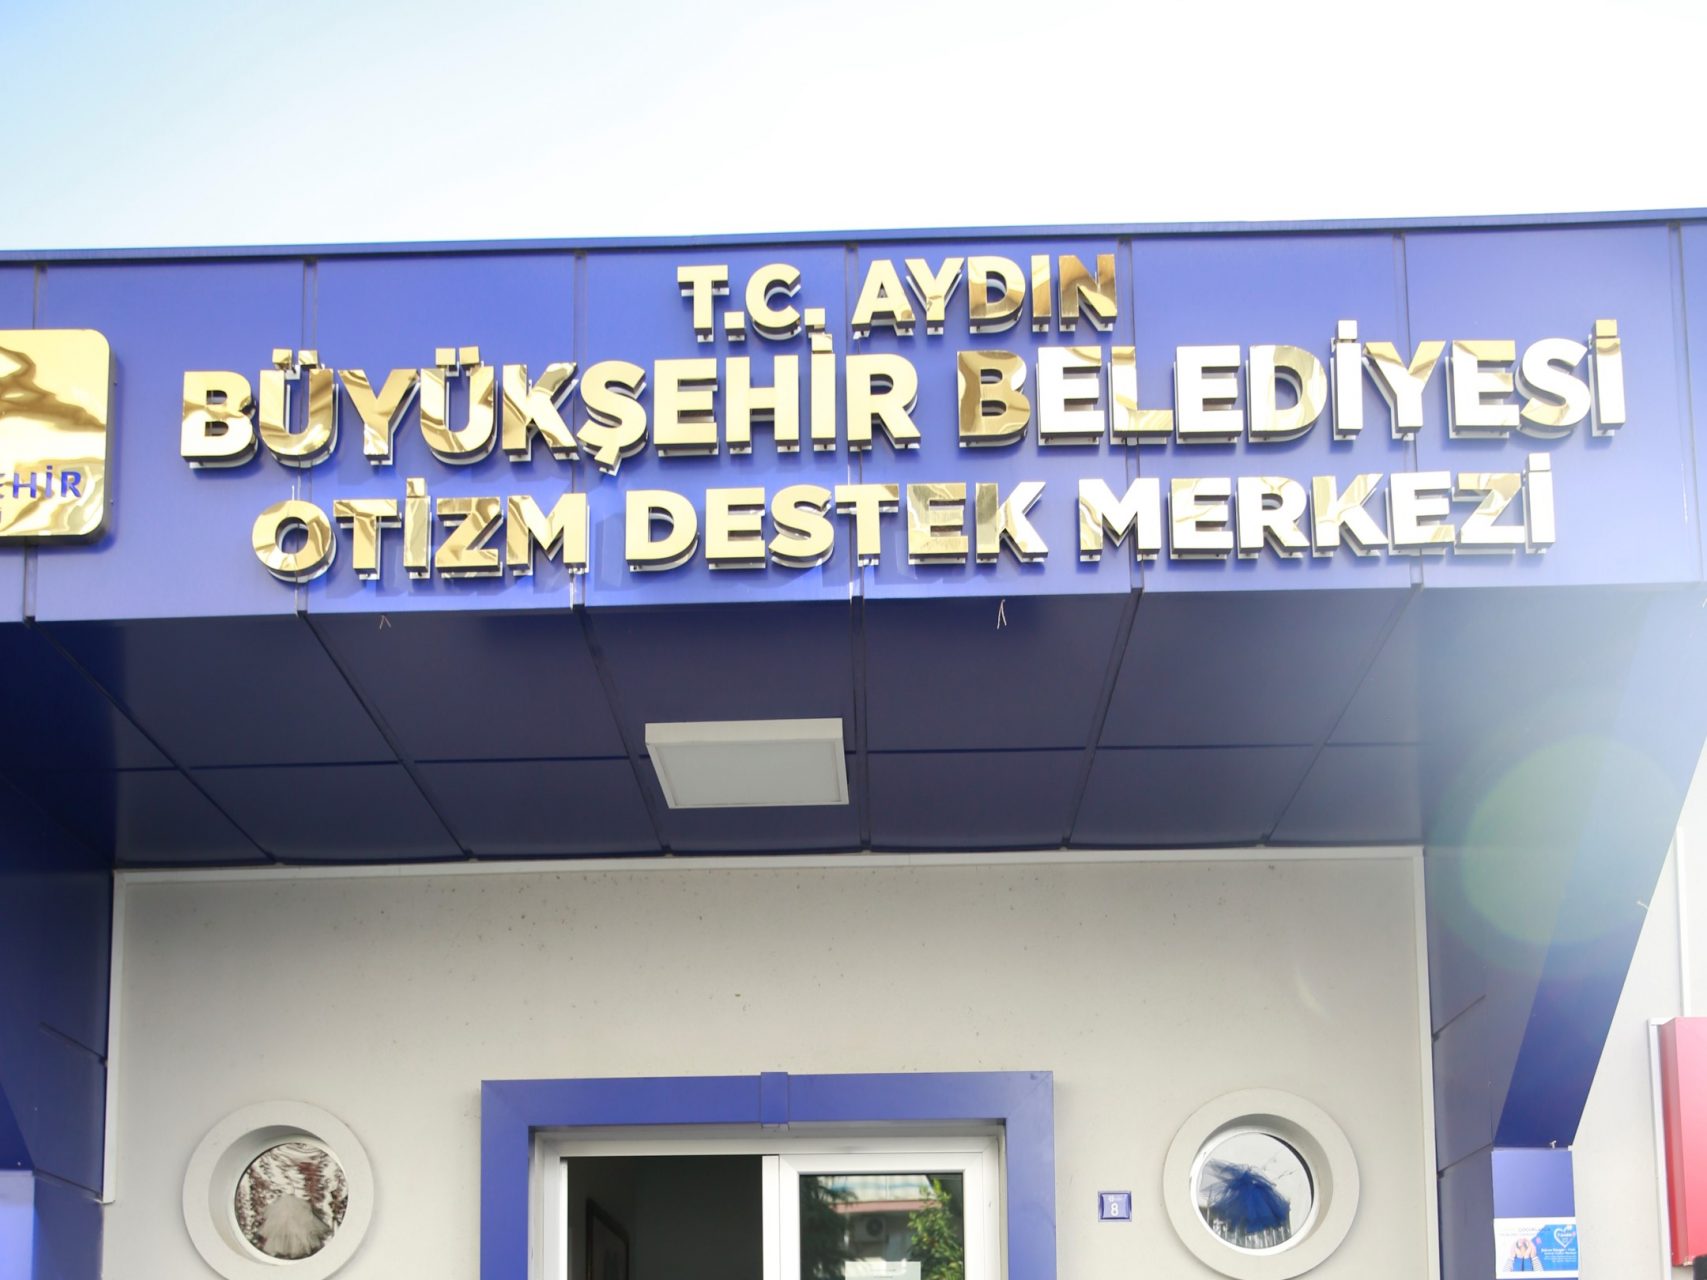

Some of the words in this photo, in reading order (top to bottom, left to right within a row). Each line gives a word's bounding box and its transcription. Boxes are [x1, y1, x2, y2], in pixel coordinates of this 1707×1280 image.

[677, 263, 826, 342] T.C.
[852, 253, 1119, 336] AYDIN
[180, 333, 920, 475] BÜYÜKŞEHİR
[956, 320, 1626, 448] BELEDİYESİ
[251, 477, 590, 583] OTİZM
[625, 481, 1049, 571] DESTEK
[1078, 453, 1556, 562] MERKEZİ
[1111, 1202, 1119, 1216] 8
